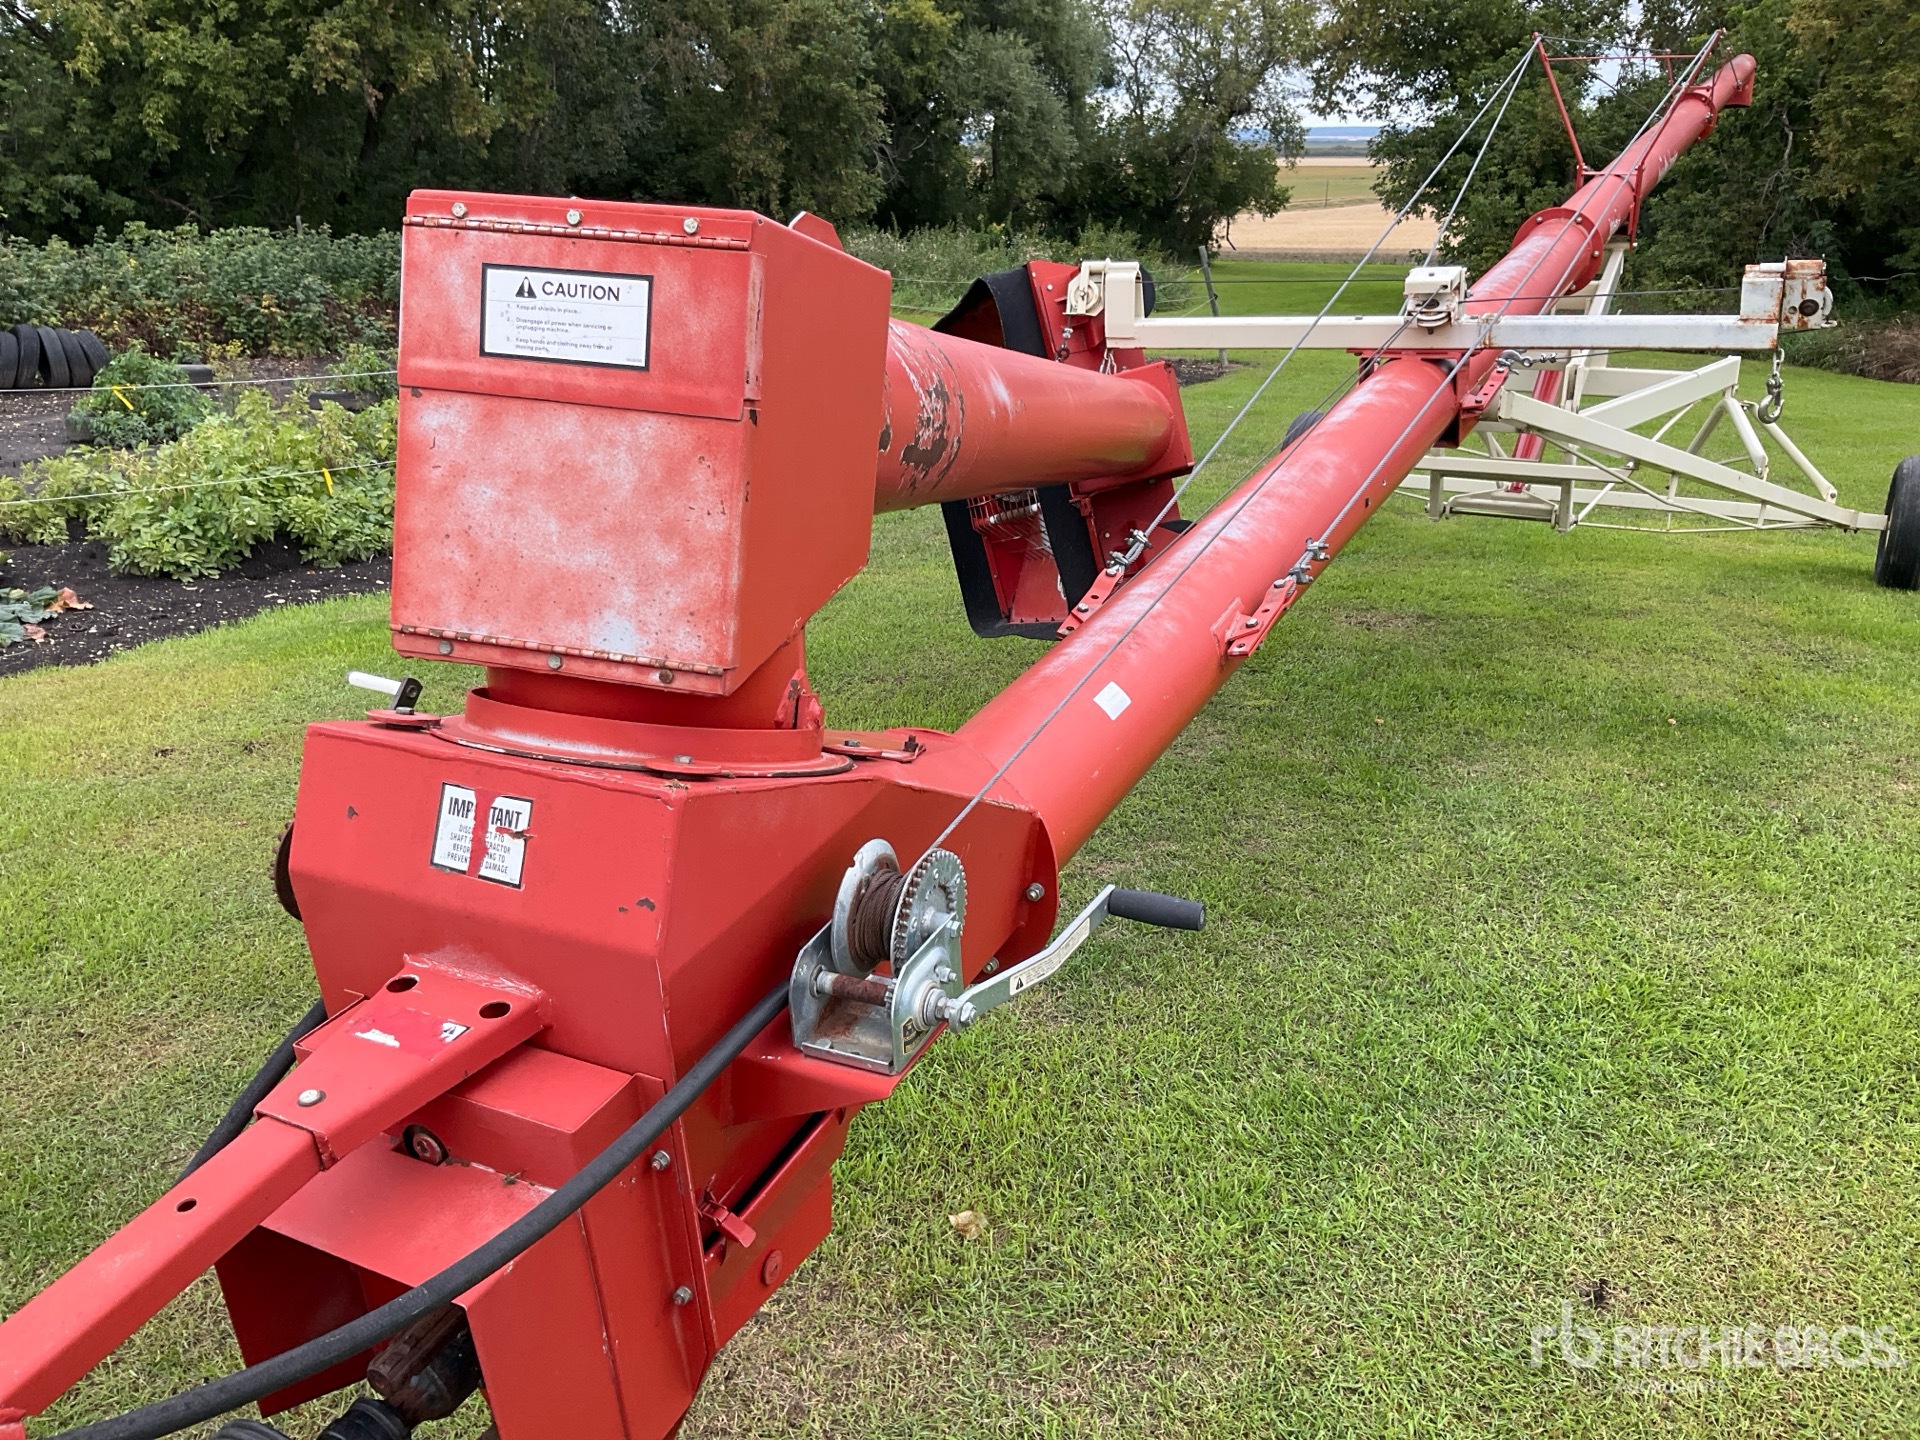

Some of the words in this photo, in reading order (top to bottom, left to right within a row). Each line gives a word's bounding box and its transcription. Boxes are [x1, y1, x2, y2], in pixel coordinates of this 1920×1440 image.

[542, 281, 620, 301] CAUTION
[583, 323, 606, 331] servicing
[448, 796, 523, 830] IMPTANT
[450, 832, 468, 843] SHAFT
[498, 854, 506, 863] TO
[484, 861, 508, 874] DAMAGE
